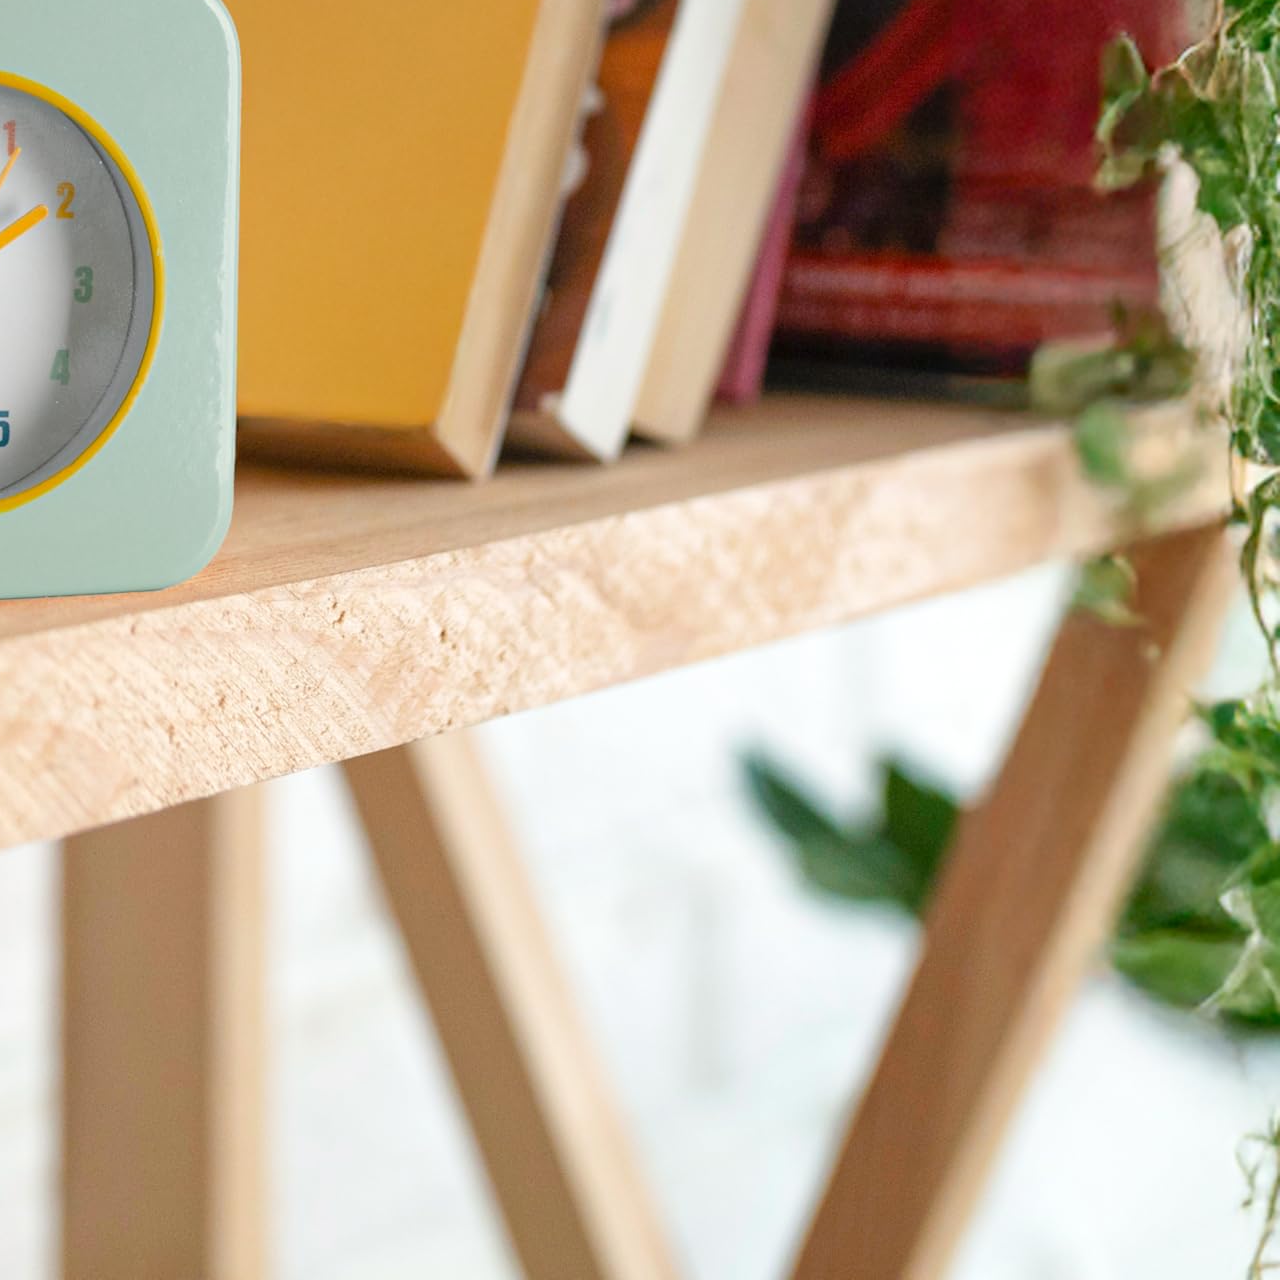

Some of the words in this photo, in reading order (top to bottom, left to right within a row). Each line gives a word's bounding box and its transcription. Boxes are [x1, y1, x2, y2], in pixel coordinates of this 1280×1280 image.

[3, 121, 17, 156] 1
[56, 182, 75, 219] 2
[73, 266, 93, 303] 3
[50, 350, 70, 386] 4
